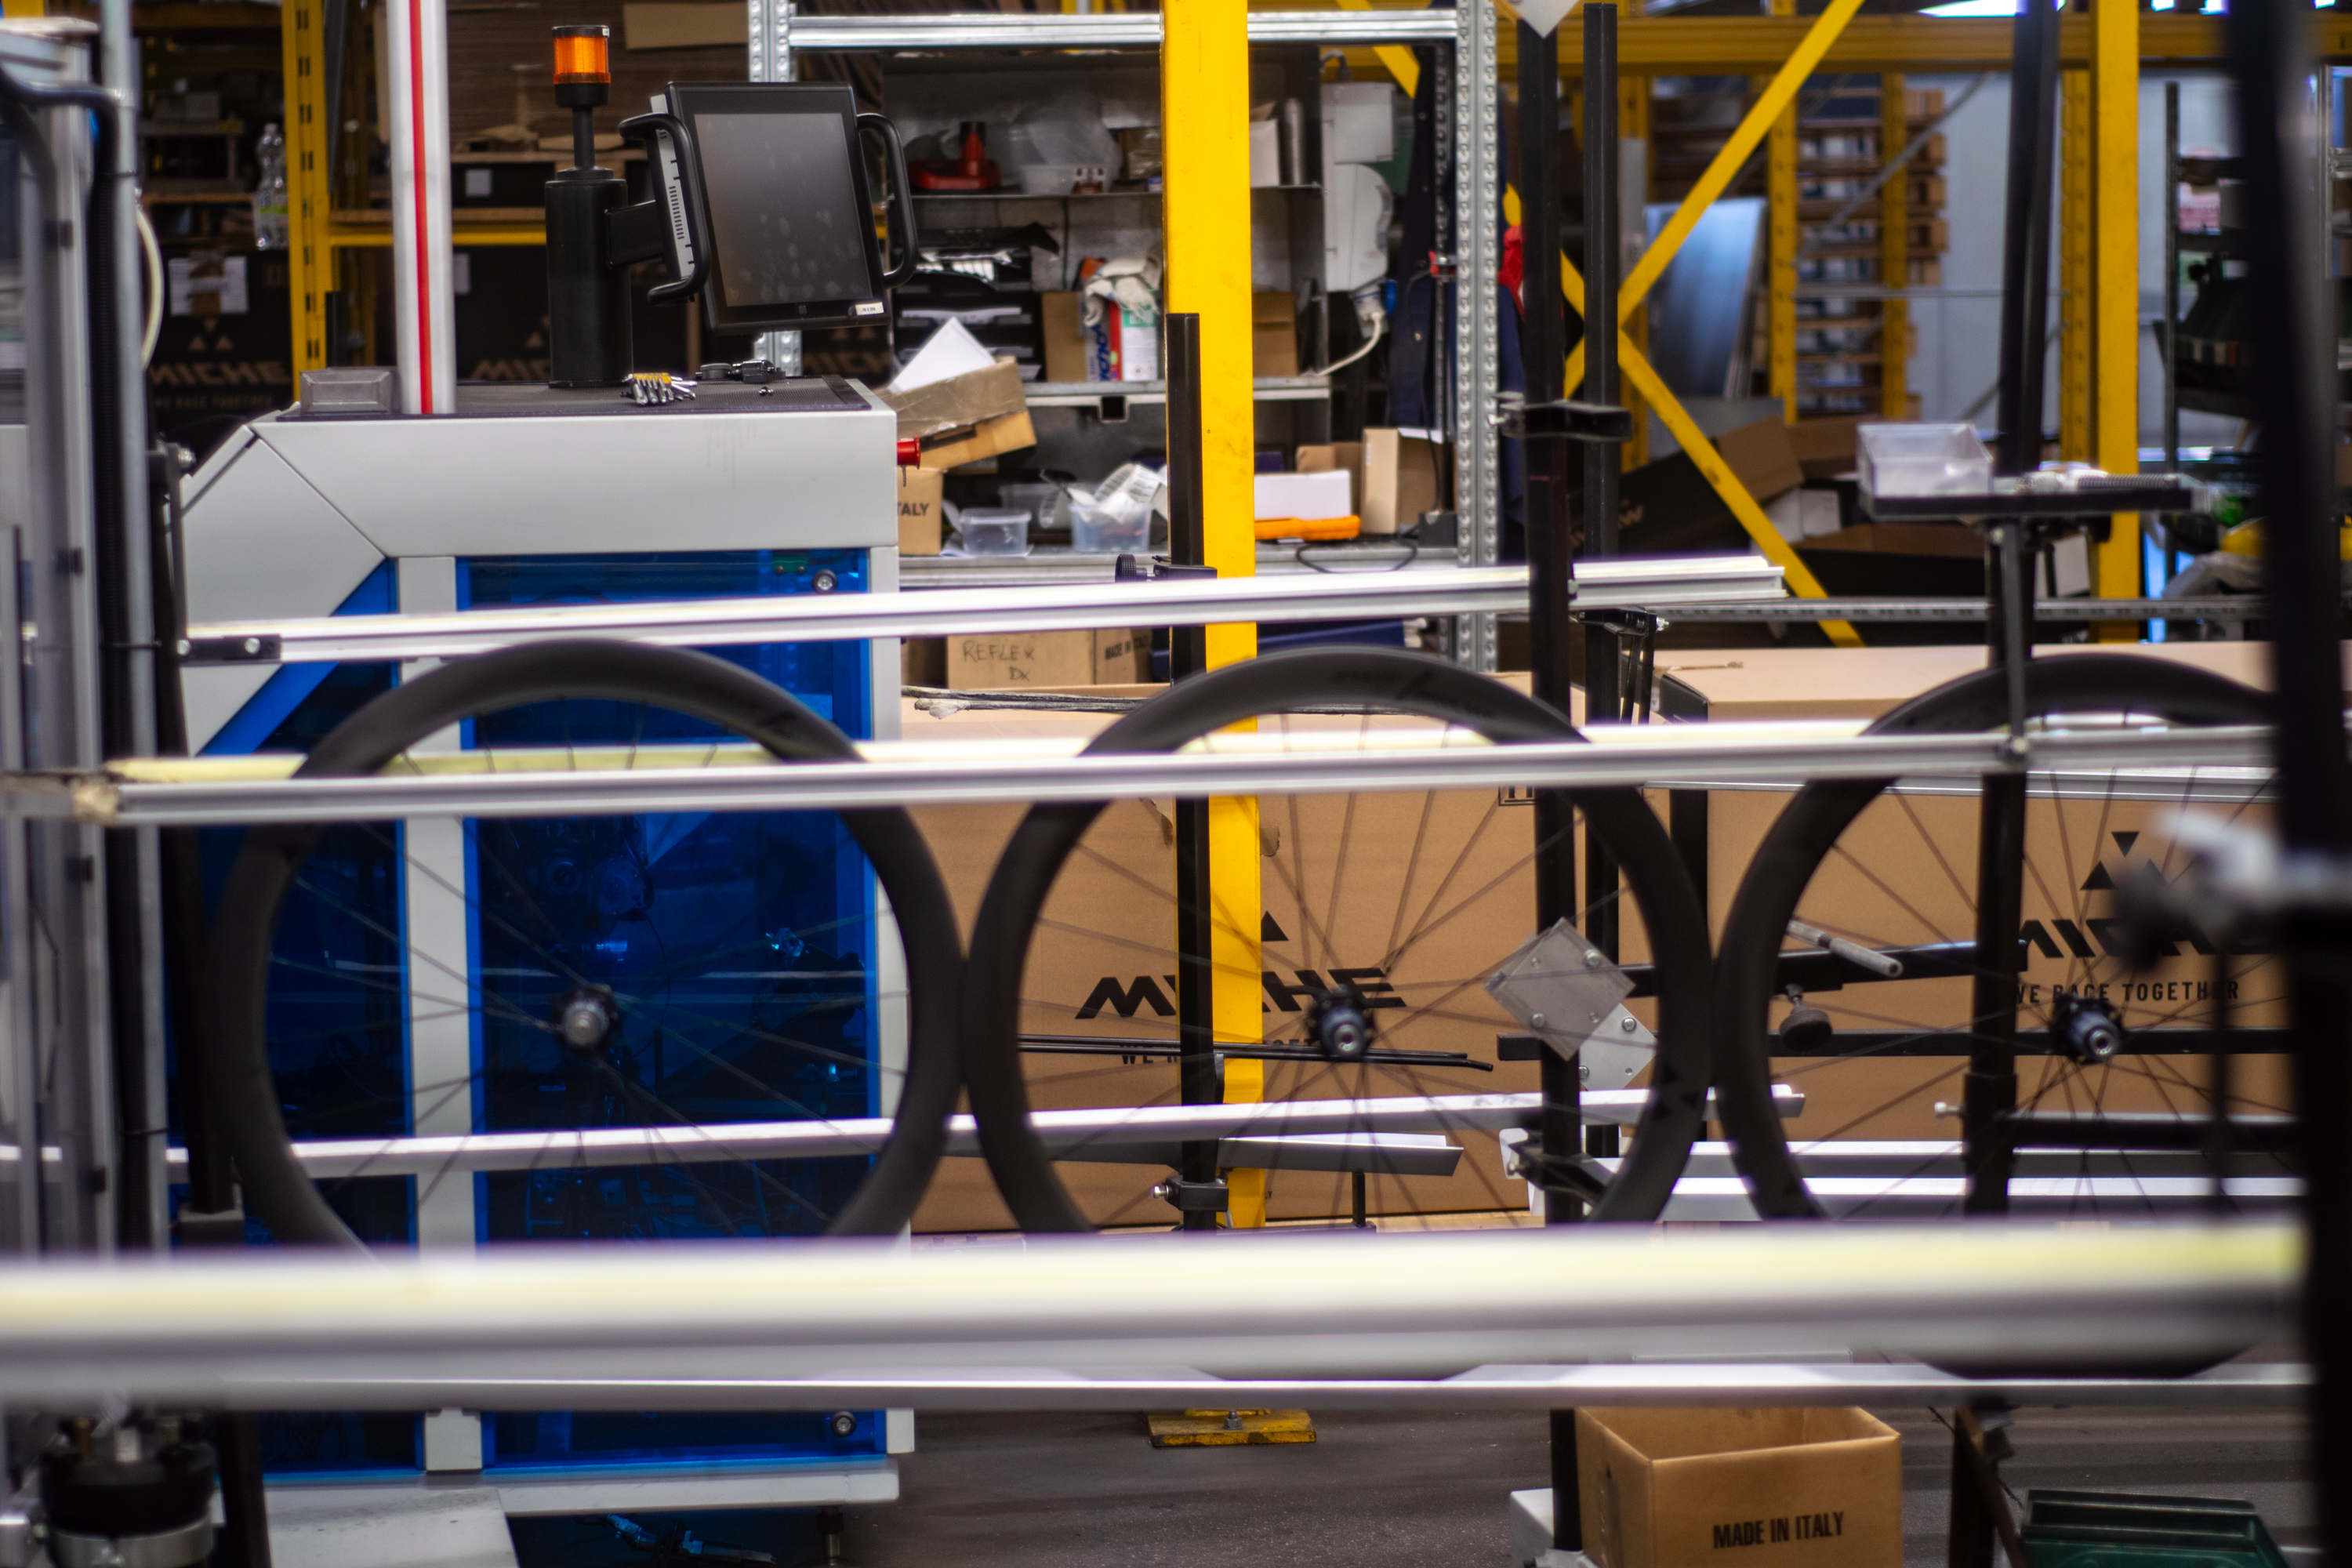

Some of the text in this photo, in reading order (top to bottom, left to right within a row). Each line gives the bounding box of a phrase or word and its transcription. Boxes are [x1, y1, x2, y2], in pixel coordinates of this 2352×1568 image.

[1713, 1510, 1844, 1549] MADE IN ITALY
